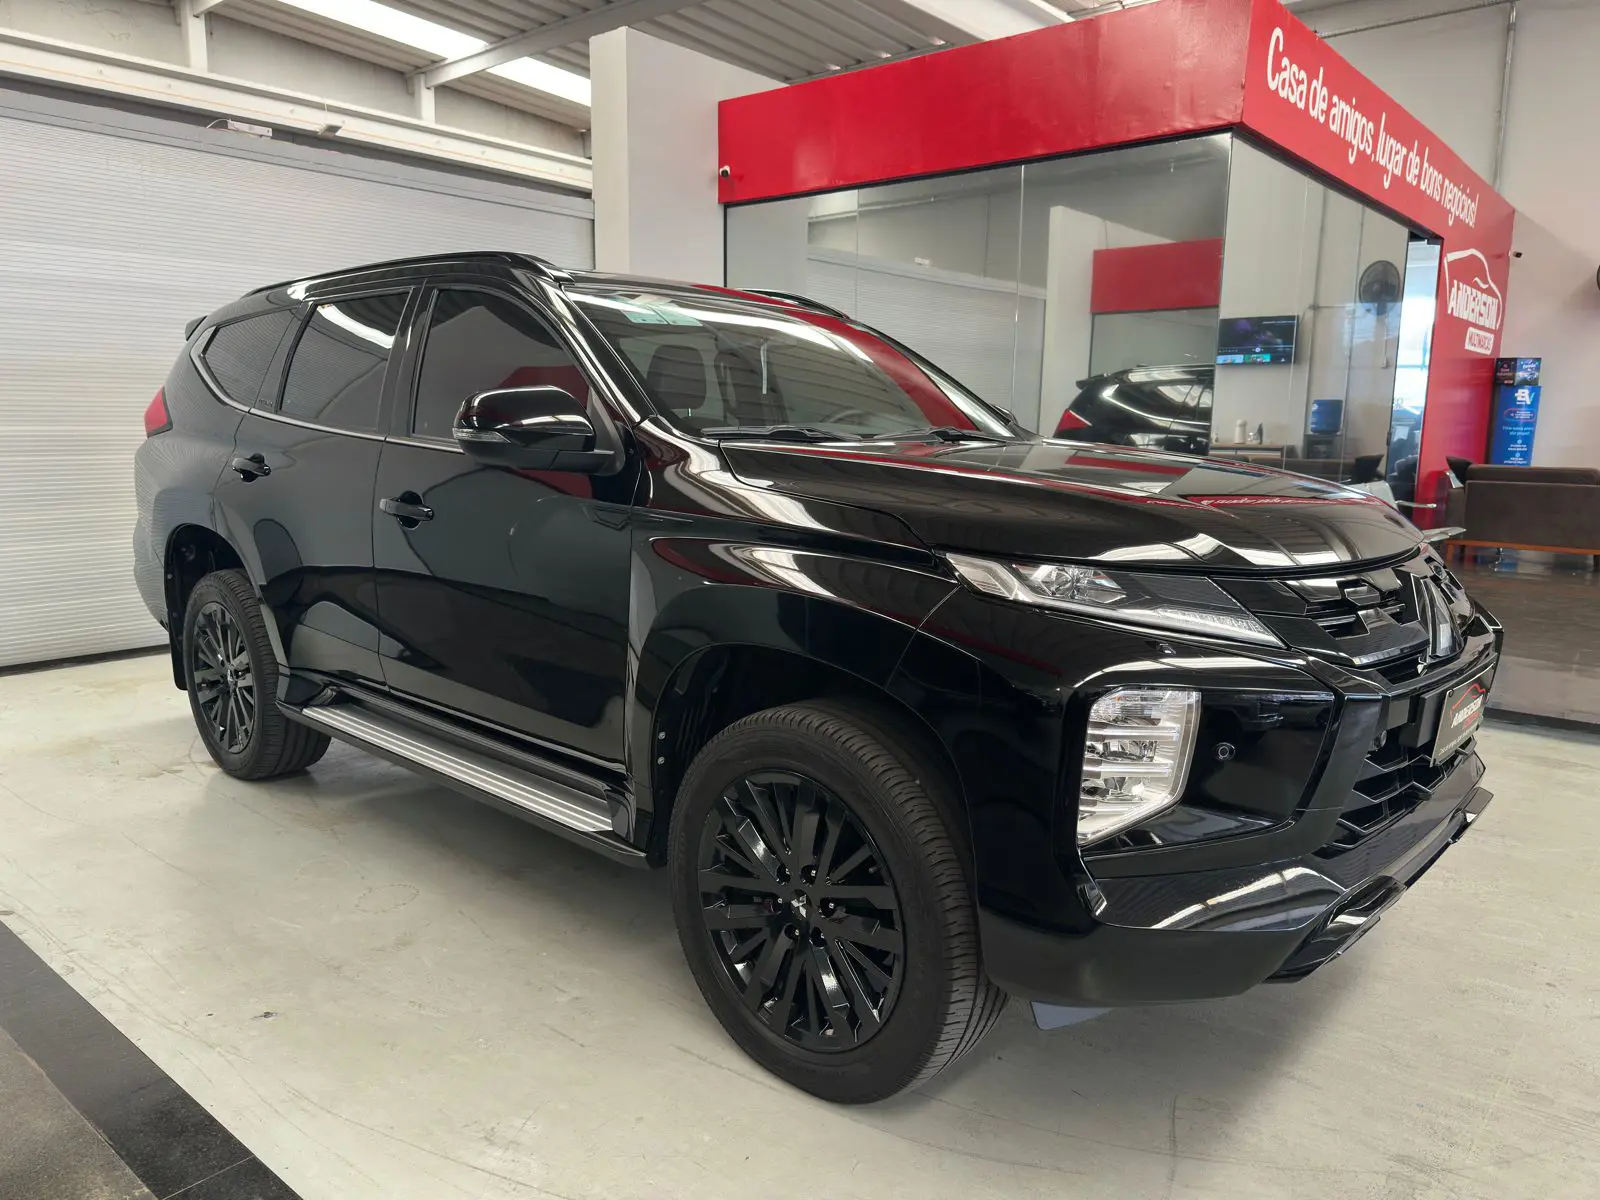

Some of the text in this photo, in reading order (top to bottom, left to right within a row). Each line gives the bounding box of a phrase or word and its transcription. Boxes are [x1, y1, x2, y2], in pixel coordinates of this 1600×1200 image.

[1267, 27, 1480, 228] Casa de amigos, lugar de bons negócios!
[1448, 279, 1498, 330] ANDERSON
